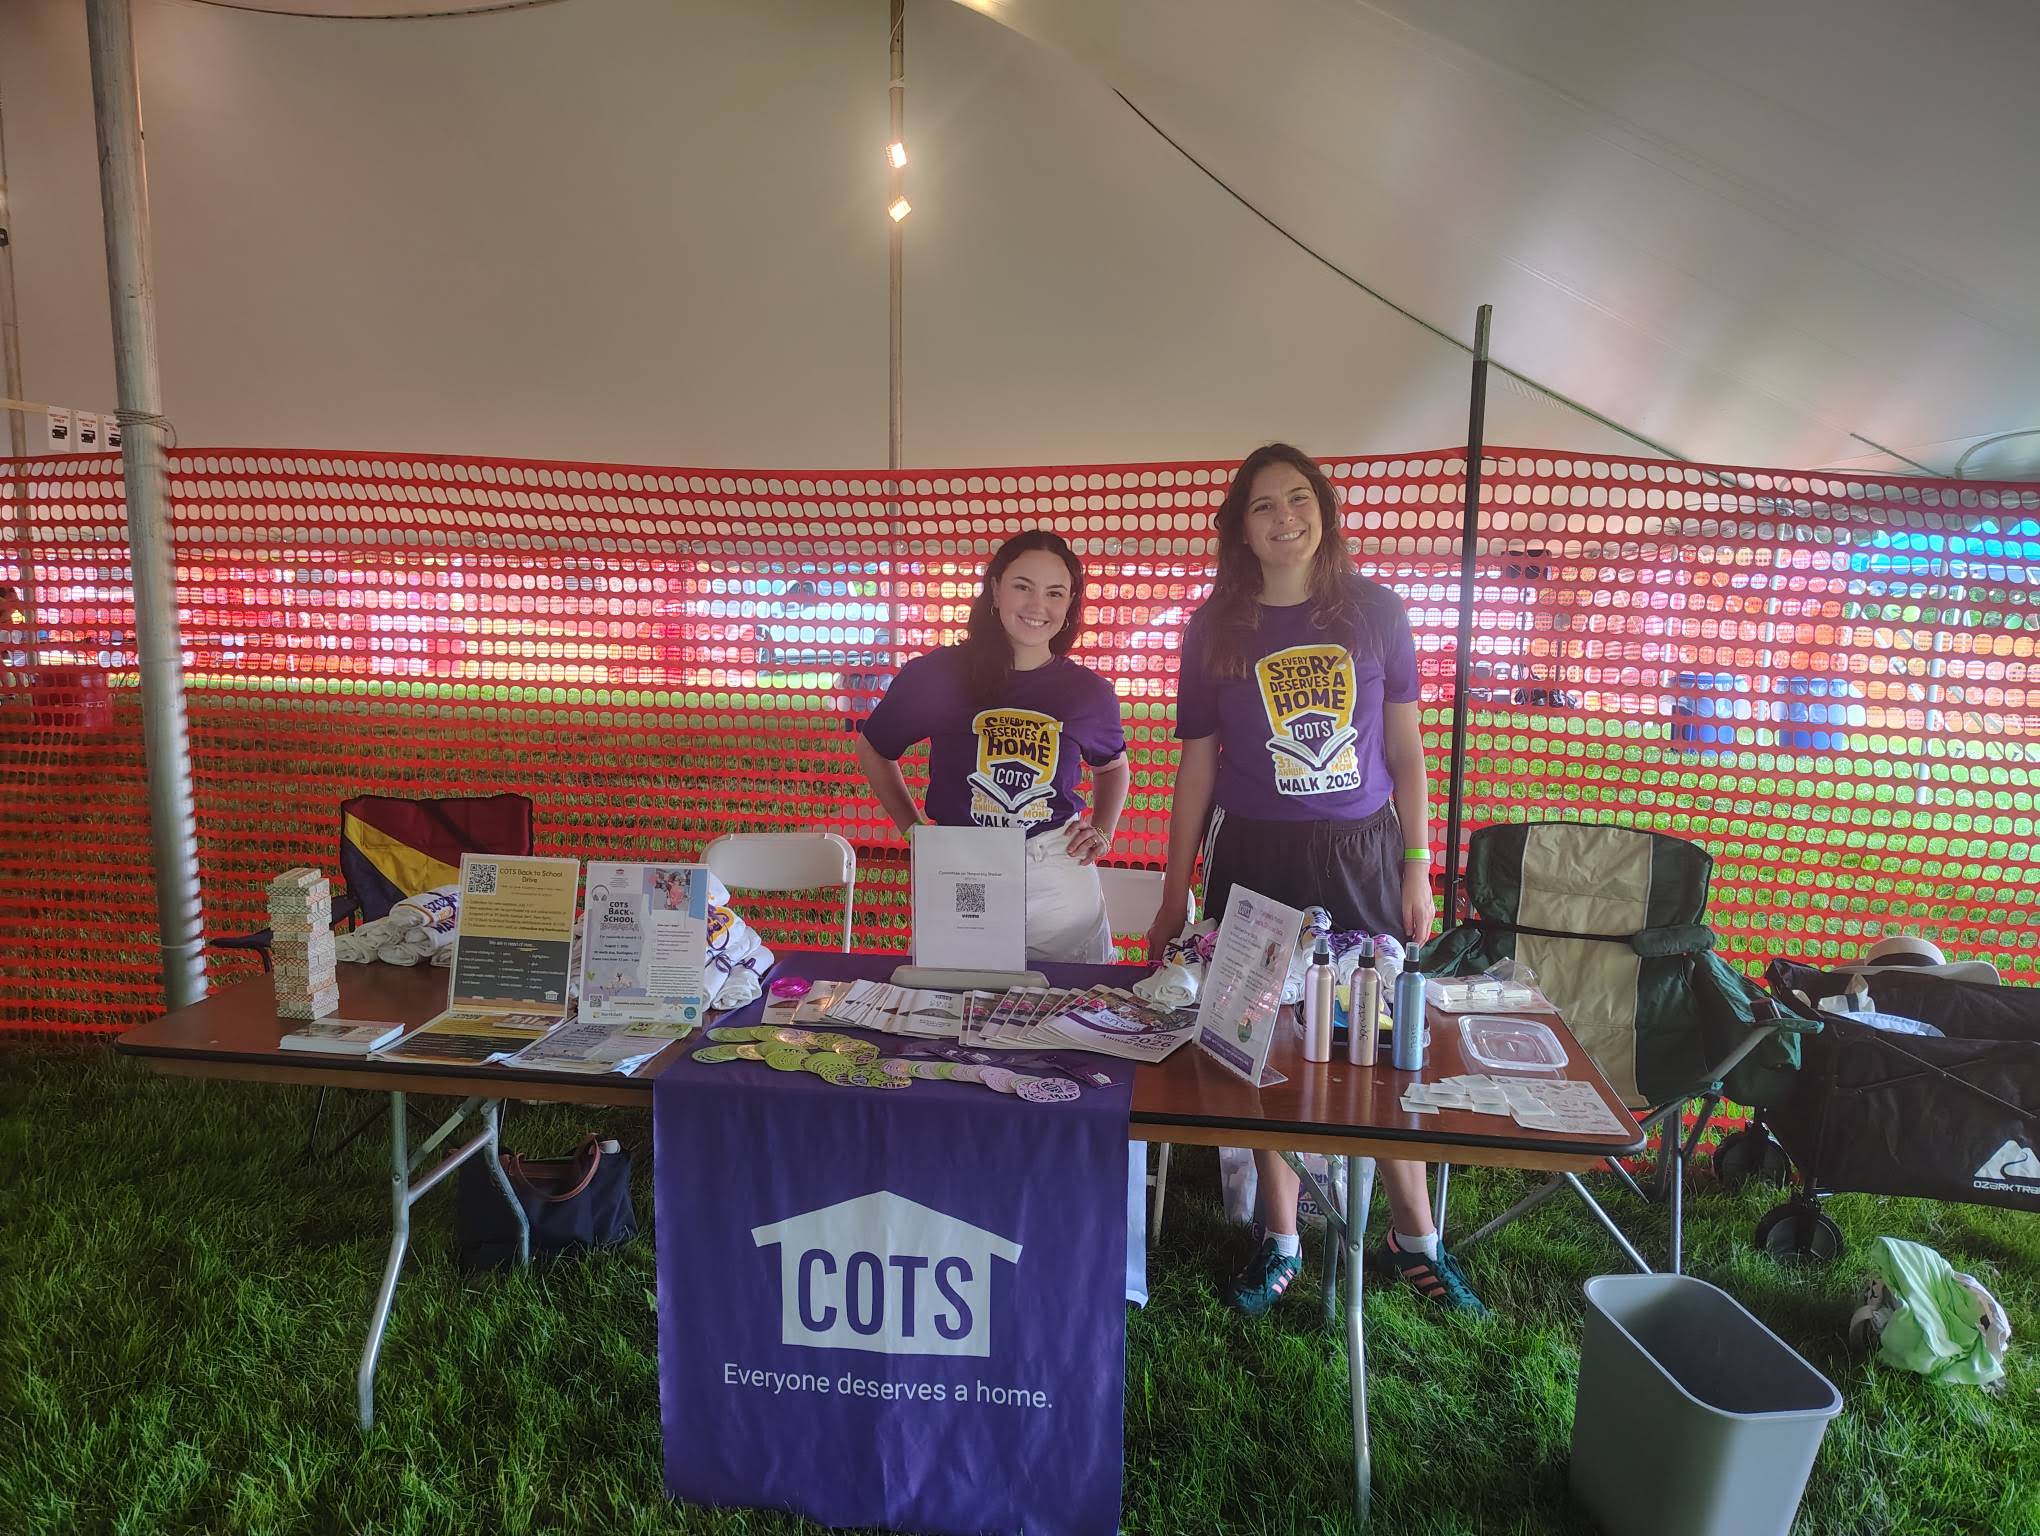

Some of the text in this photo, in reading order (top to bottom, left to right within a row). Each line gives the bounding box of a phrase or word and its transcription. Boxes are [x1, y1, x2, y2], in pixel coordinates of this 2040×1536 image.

[1267, 655, 1338, 681] STORY
[1282, 656, 1308, 666] EVERY
[1270, 671, 1346, 693] DESERVES A
[1274, 688, 1346, 717] HOME
[983, 727, 1051, 744] DESERVES A
[1295, 720, 1331, 741] COTS
[987, 737, 1051, 767] HOME
[996, 768, 1031, 789] COTS
[1279, 771, 1359, 792] WALK 2026
[973, 812, 1010, 828] WALK
[500, 867, 516, 875] COTS
[518, 868, 533, 876] Back
[542, 869, 563, 878] School
[603, 915, 634, 923] SCHOOL
[1127, 1035, 1171, 1048] 2026
[1133, 1042, 1165, 1051] Report
[798, 1248, 974, 1341] COTS
[724, 1363, 1053, 1409] Everyone deserves a home.
